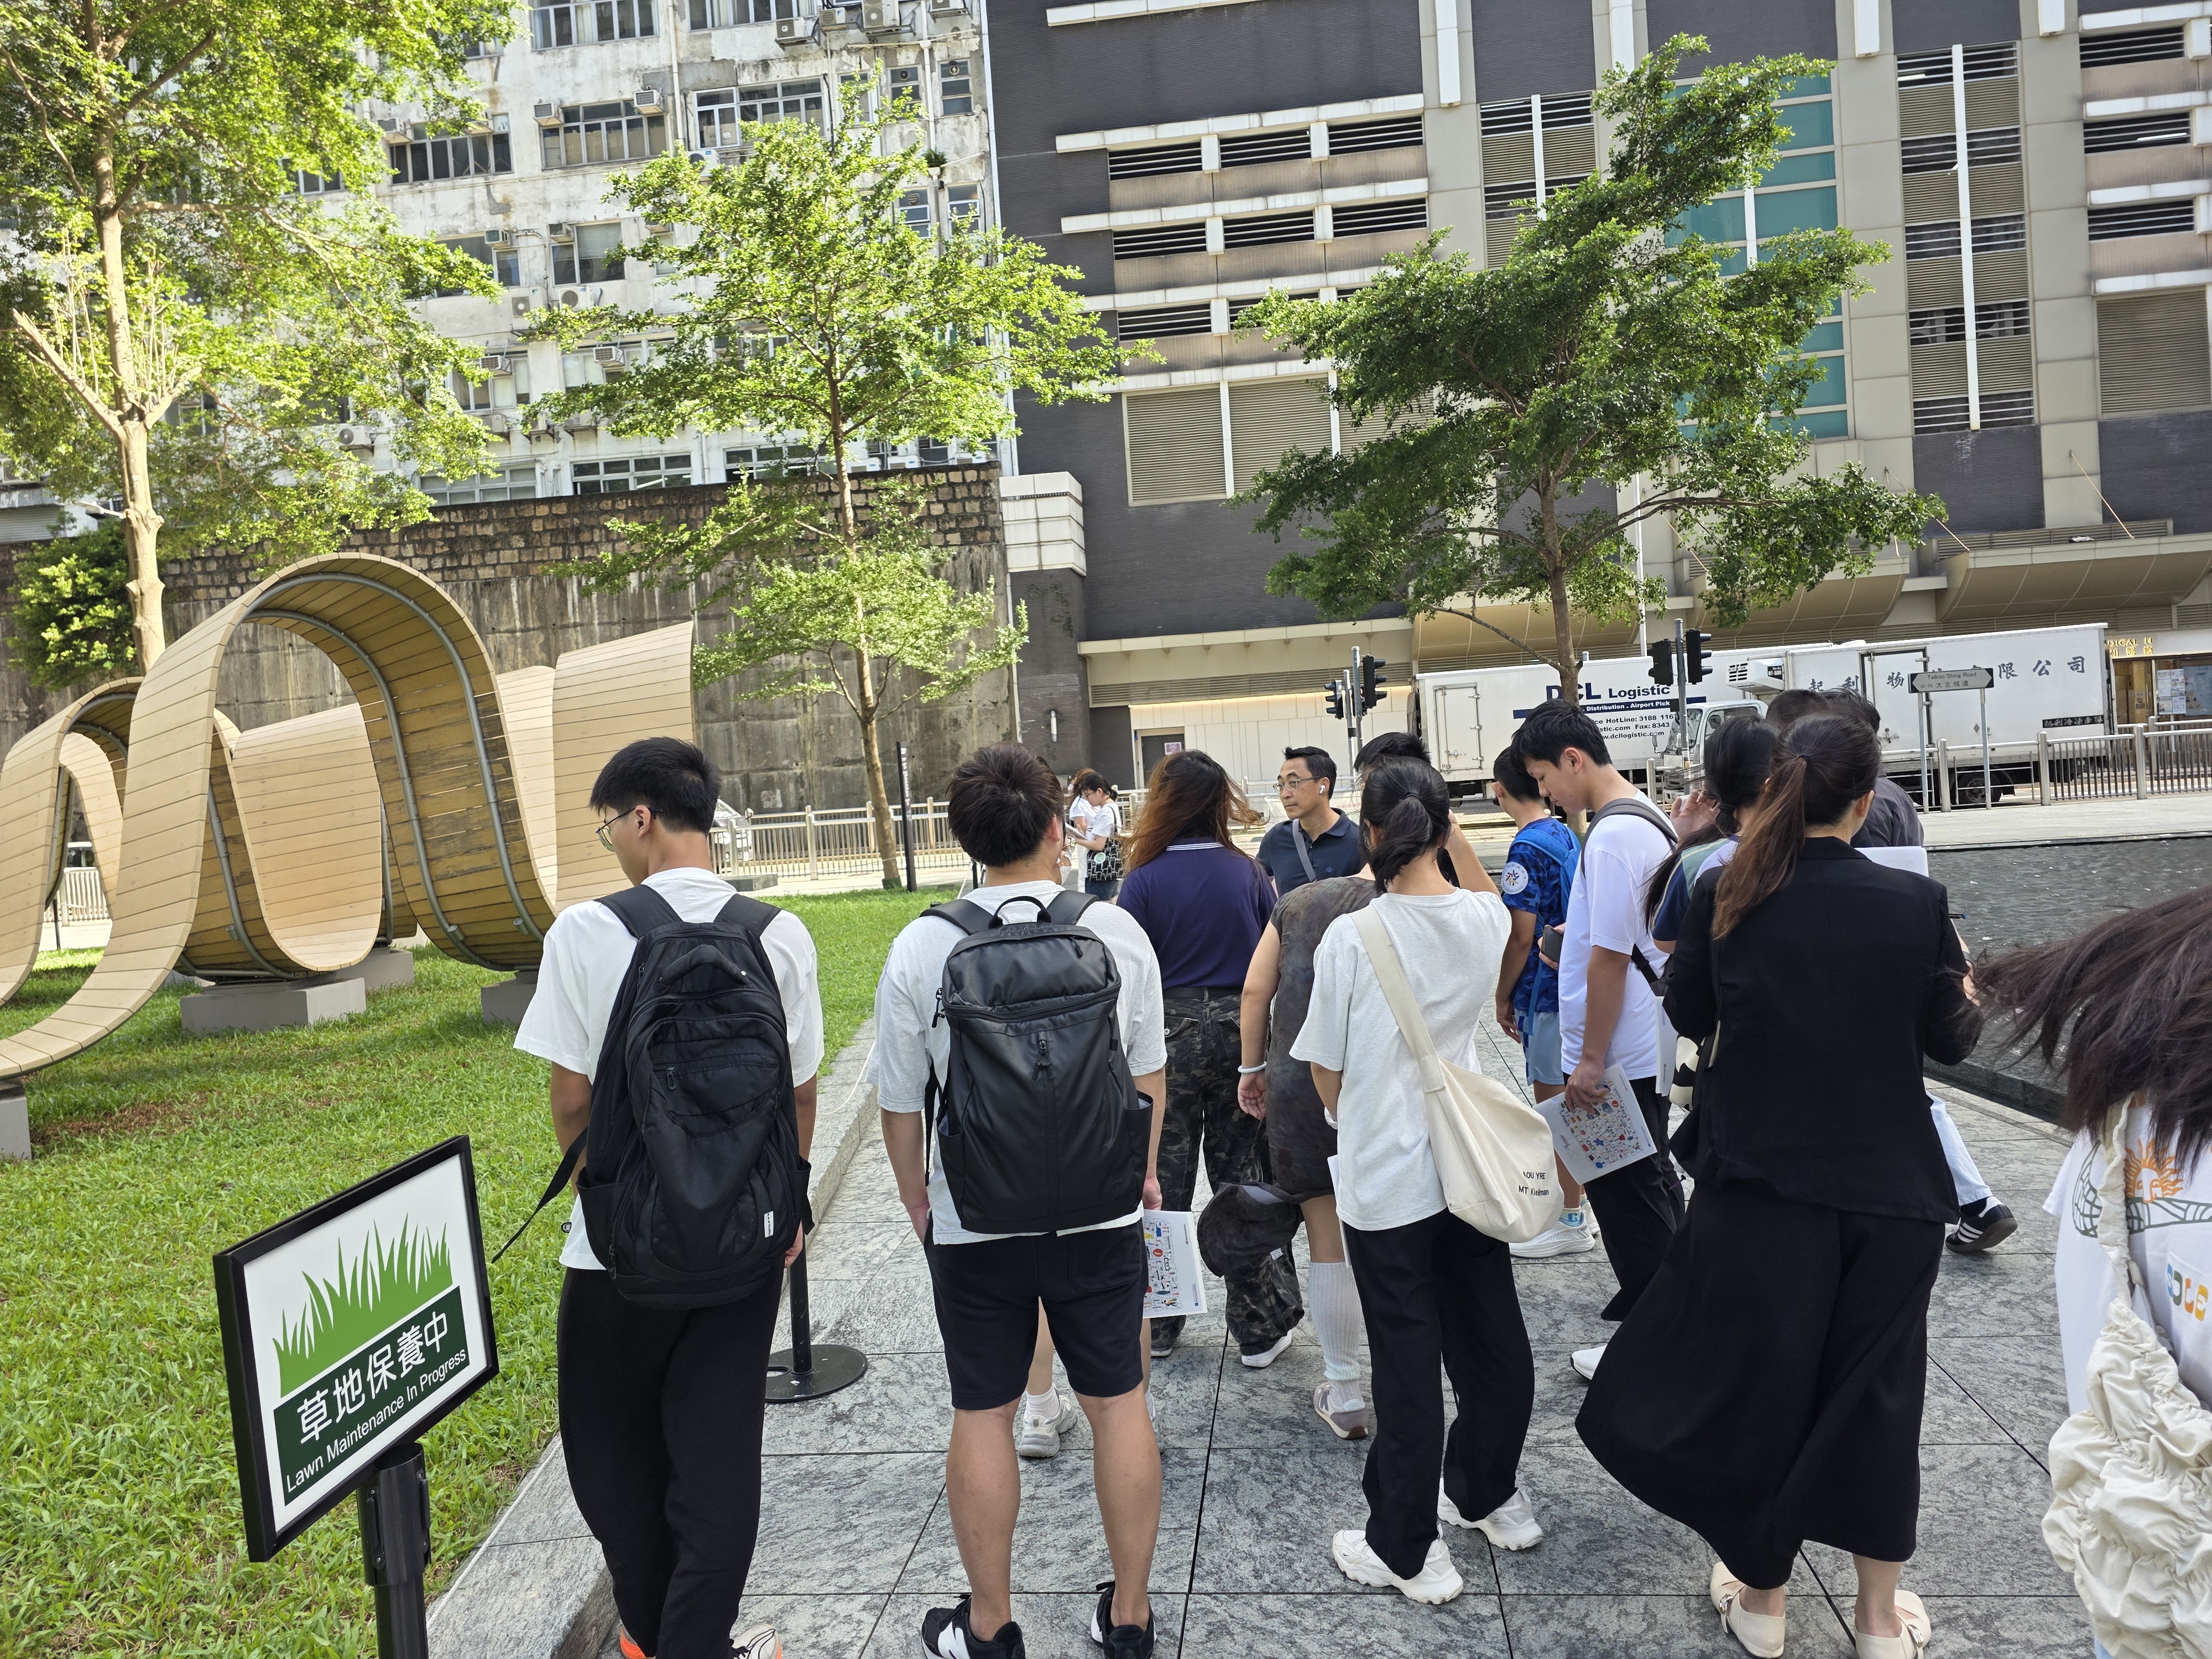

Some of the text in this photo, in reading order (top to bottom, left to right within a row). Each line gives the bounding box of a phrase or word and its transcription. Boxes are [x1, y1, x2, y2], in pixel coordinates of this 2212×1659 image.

[1546, 682, 1671, 701] DL Logistic
[1936, 680, 1969, 688] 太古城道
[1586, 703, 1625, 712] Distribution
[1603, 731, 1665, 740] w.dcllogistic.com
[2167, 1262, 2209, 1322] SOLE
[297, 1311, 448, 1444] 草地保養中
[286, 1348, 466, 1493] Lawn Maintenance In Progress
